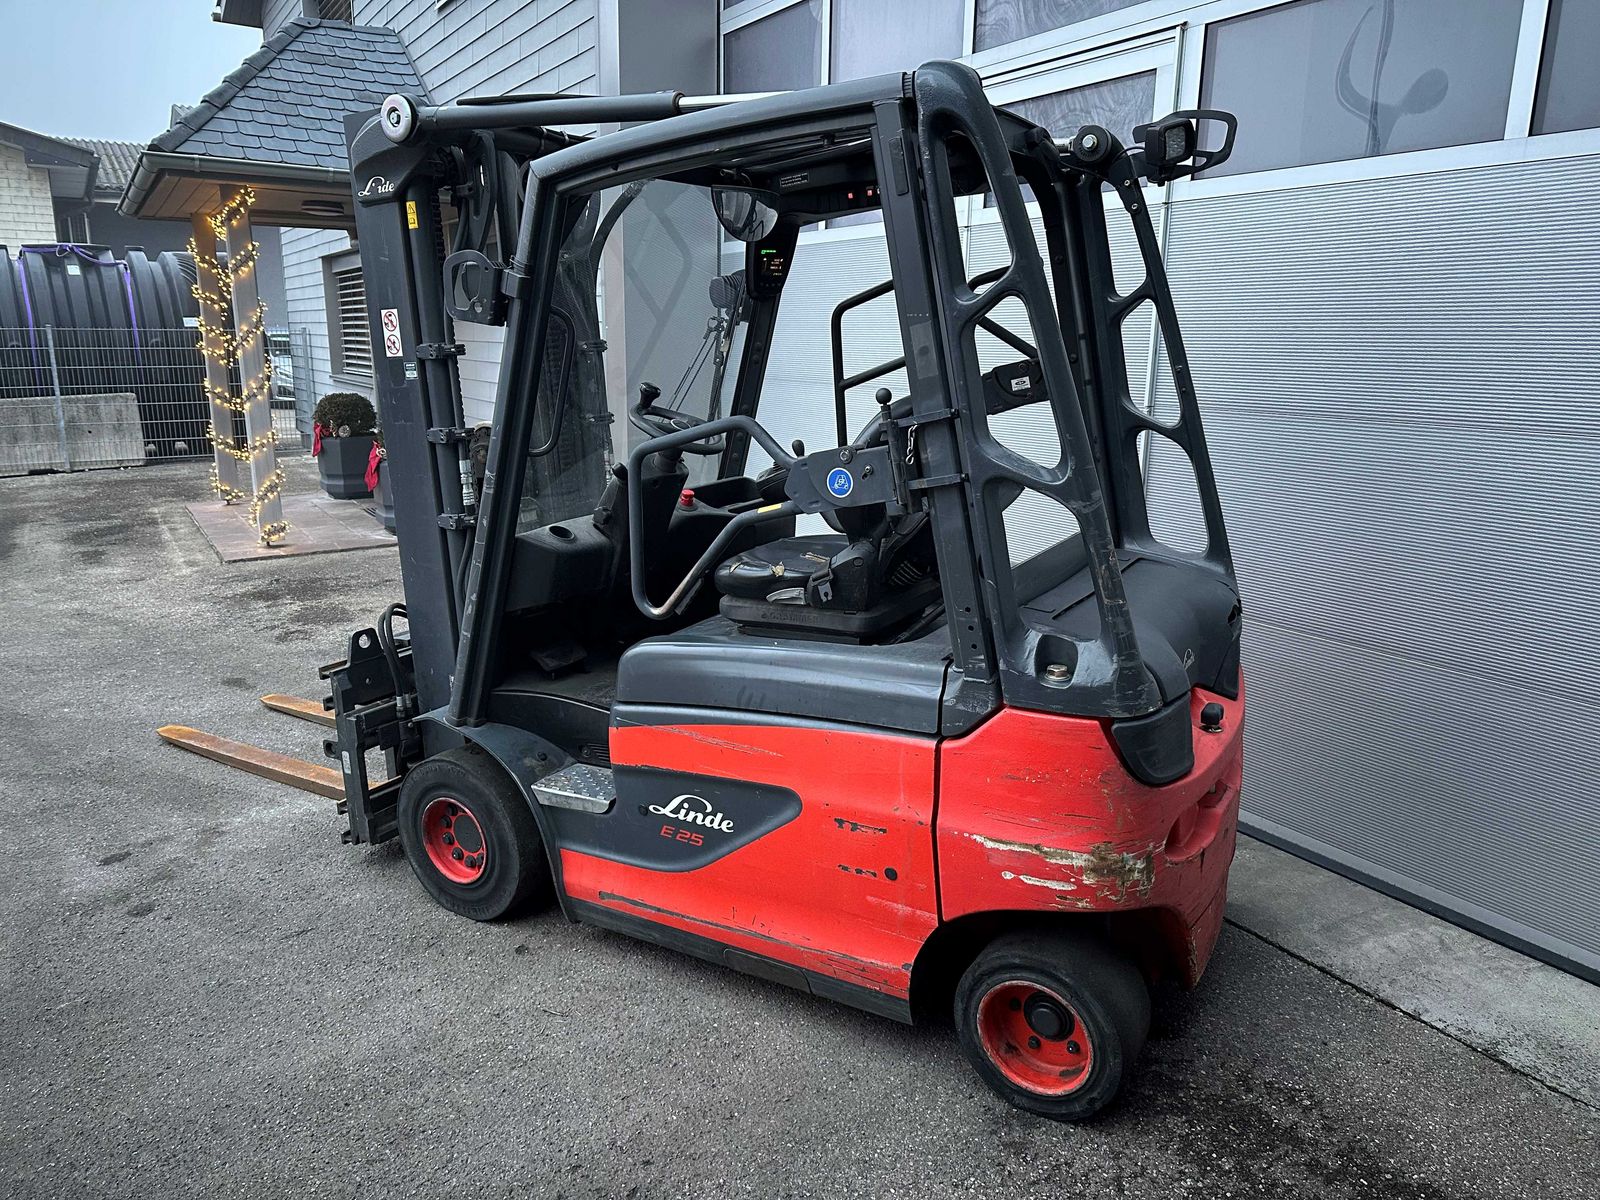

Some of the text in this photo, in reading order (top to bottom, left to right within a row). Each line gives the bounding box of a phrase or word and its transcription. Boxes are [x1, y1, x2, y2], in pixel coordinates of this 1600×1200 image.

[358, 176, 395, 196] Lde
[648, 794, 734, 833] Linde
[660, 825, 704, 847] E 25
